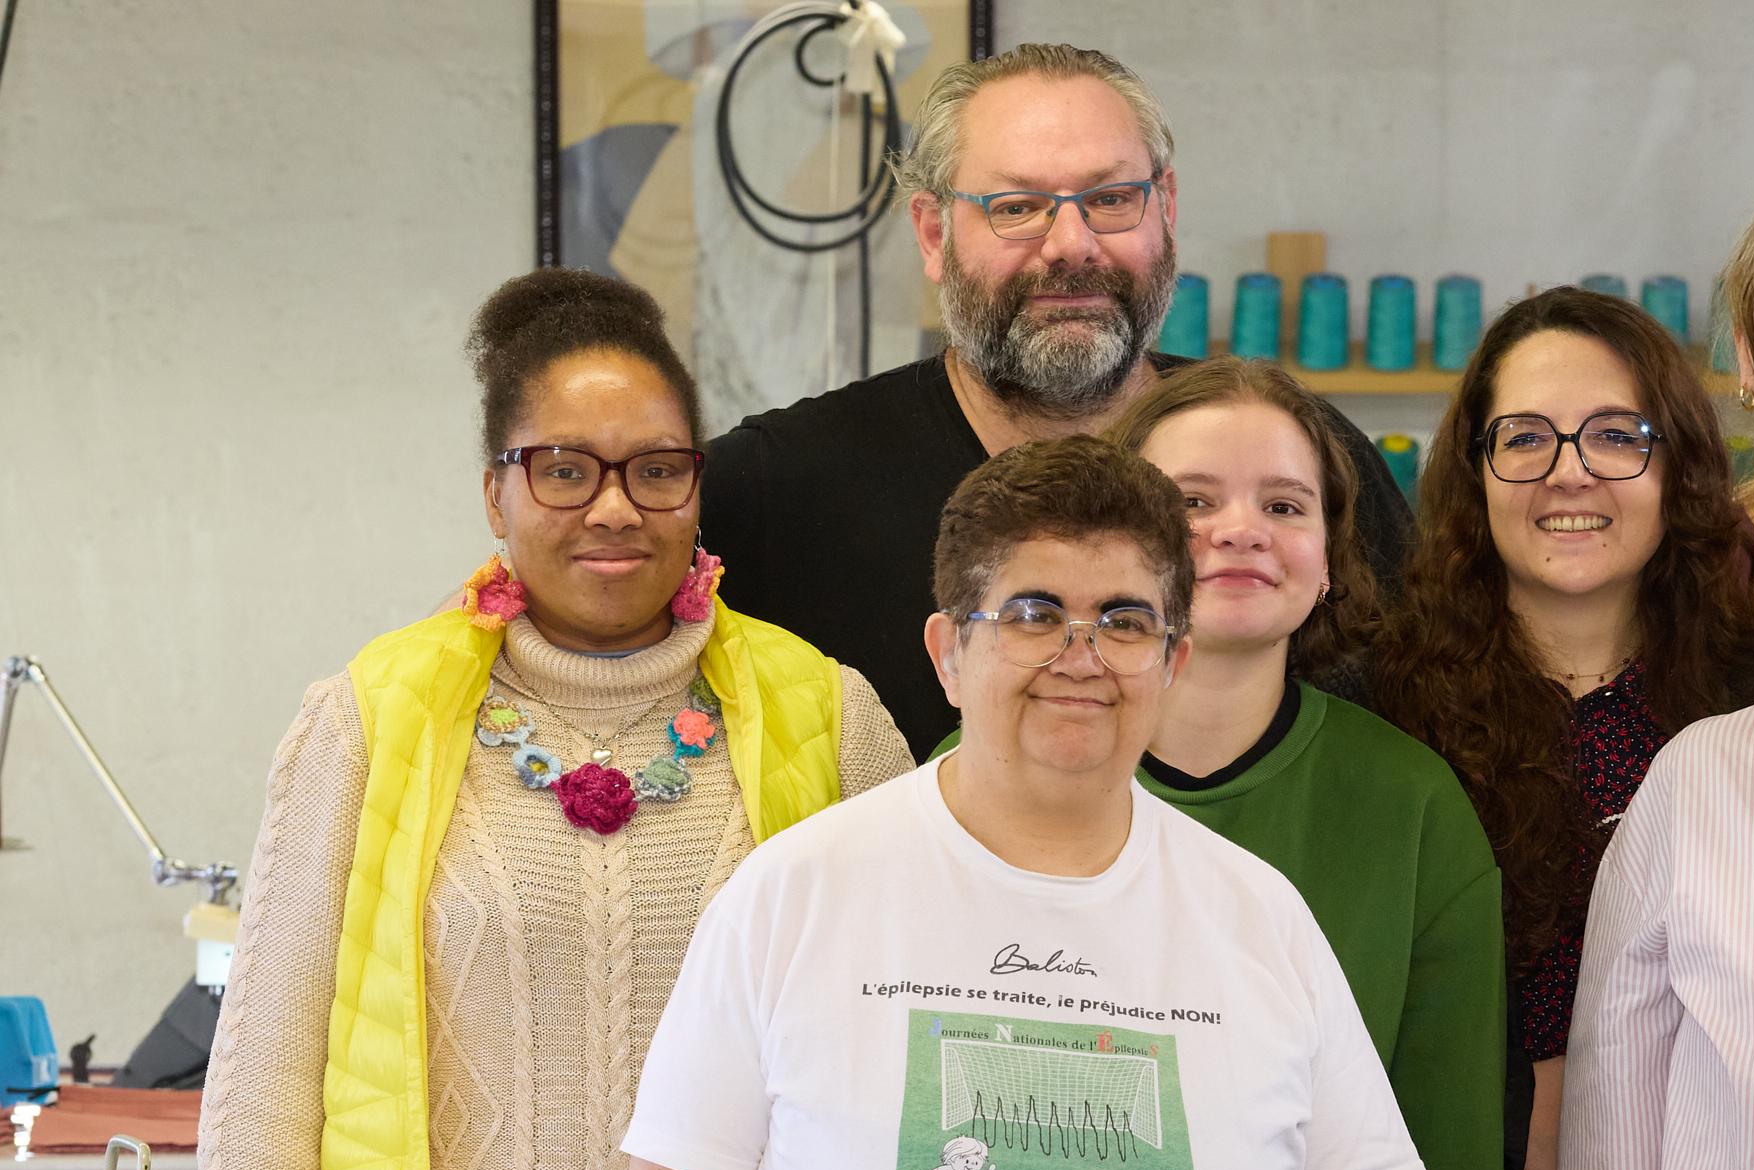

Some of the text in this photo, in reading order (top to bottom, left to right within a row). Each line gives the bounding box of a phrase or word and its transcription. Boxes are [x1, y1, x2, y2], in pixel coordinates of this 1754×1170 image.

[862, 981, 962, 999] L'épilepsie
[967, 988, 987, 999] se
[993, 989, 1052, 1009] traite,
[1080, 998, 1166, 1021] préjudice
[1171, 1008, 1222, 1025] NON!
[928, 1018, 989, 1040] Journées
[995, 1023, 1068, 1049] Nationales
[1072, 1039, 1086, 1051] de
